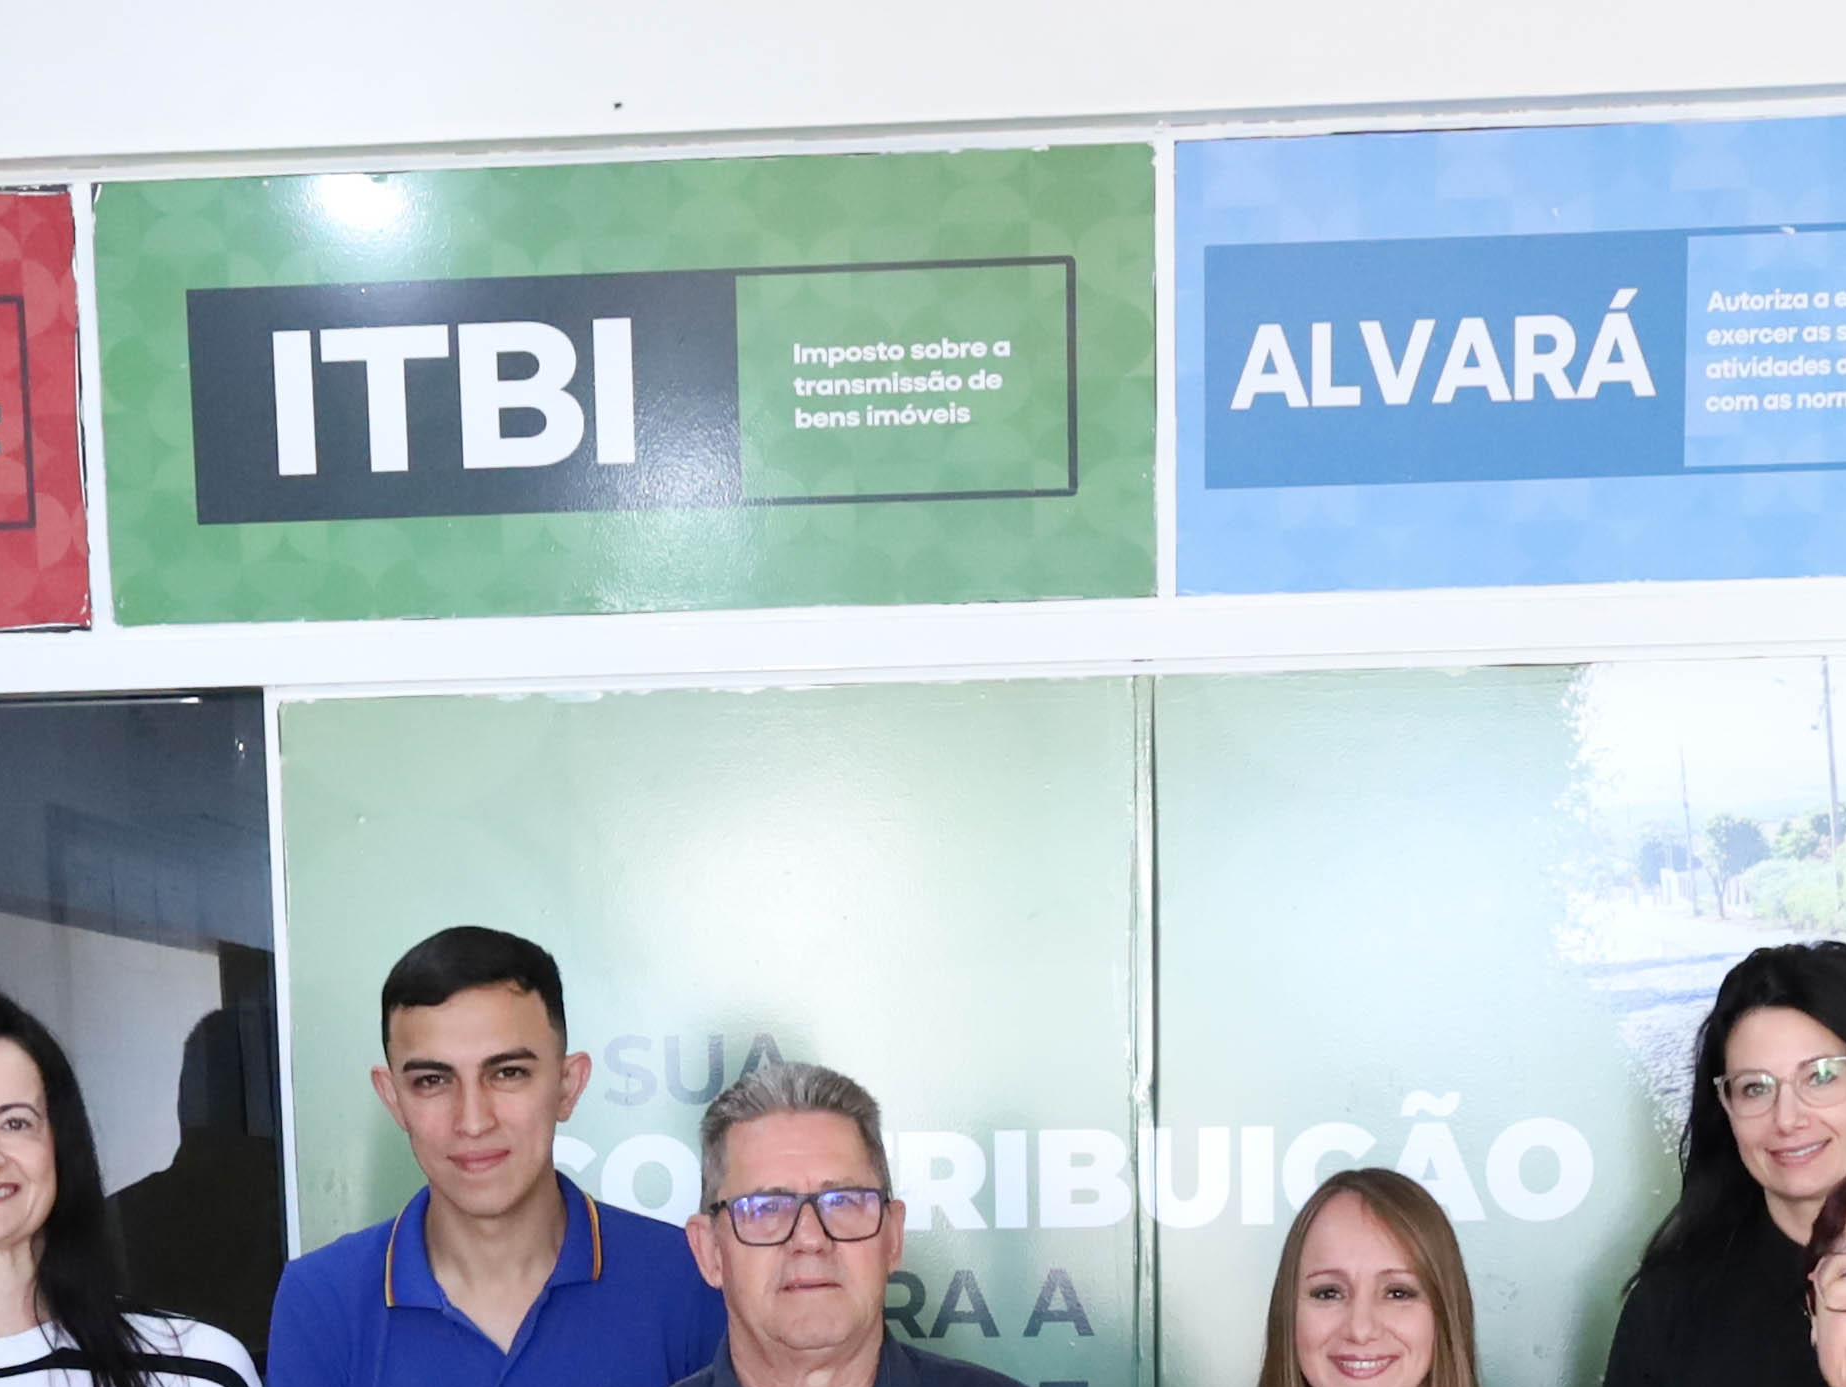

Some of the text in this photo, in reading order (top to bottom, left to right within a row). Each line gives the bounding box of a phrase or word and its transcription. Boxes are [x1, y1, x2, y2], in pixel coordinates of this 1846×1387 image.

[1706, 288, 1808, 312] Autoriza
[1813, 292, 1829, 308] a
[1229, 287, 1656, 410] ALVARÁ
[1706, 326, 1797, 346] exercer
[1802, 325, 1831, 342] as
[793, 337, 1011, 368] Imposto sobre a
[1706, 355, 1831, 379] atividades
[271, 317, 635, 476] ITBI
[793, 369, 1003, 397] transmissão de
[794, 402, 971, 429] bens imóveis
[1705, 393, 1759, 412] com
[1763, 393, 1792, 410] as
[603, 1031, 790, 1106] SUA
[1023, 1268, 1094, 1337] A
